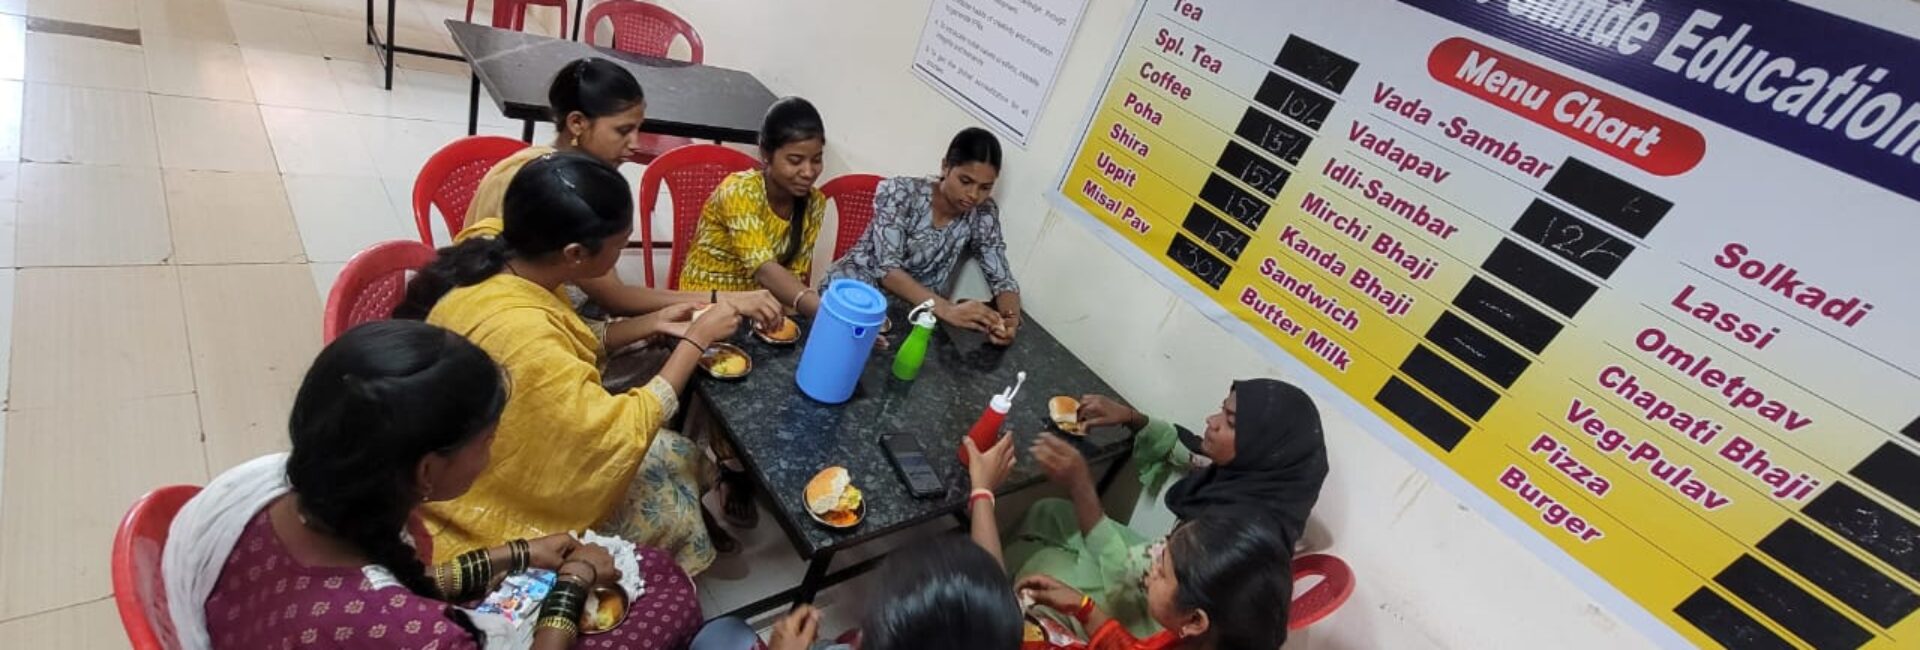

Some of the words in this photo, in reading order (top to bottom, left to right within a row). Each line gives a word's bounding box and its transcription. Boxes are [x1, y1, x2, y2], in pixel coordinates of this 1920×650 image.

[1139, 62, 1192, 100] Coffee
[1155, 28, 1183, 56] Spl.
[1191, 44, 1222, 73] Tea
[1653, 9, 1920, 164] Education
[1110, 123, 1149, 157] Shira
[1124, 92, 1163, 126] Poha
[1373, 82, 1432, 125] Vada
[1455, 50, 1550, 110] Menu
[1553, 91, 1661, 157] Chart
[1097, 152, 1137, 188] Uppit
[1348, 120, 1451, 184] Vadapav
[1083, 180, 1122, 213] Misal
[1121, 207, 1150, 234] Pav
[1323, 158, 1458, 240] Idli-Sambar
[1279, 226, 1348, 276] Kanda
[1350, 268, 1414, 316] Bhaji
[1300, 193, 1372, 242] Mirchi
[1371, 232, 1439, 281] Bhaji
[1260, 258, 1359, 331] Sandwich
[1671, 285, 1780, 350] Lassi
[1714, 242, 1873, 327] Solkadi
[1240, 287, 1302, 336] Butter
[1305, 331, 1353, 371] Milk
[1635, 328, 1813, 432] Omletpav
[1530, 434, 1610, 497] Pizza
[1566, 399, 1729, 510] Veg-Pulav
[1598, 365, 1722, 446] Chapati
[1718, 435, 1820, 501] Bhaji
[1499, 466, 1602, 541] Burger
